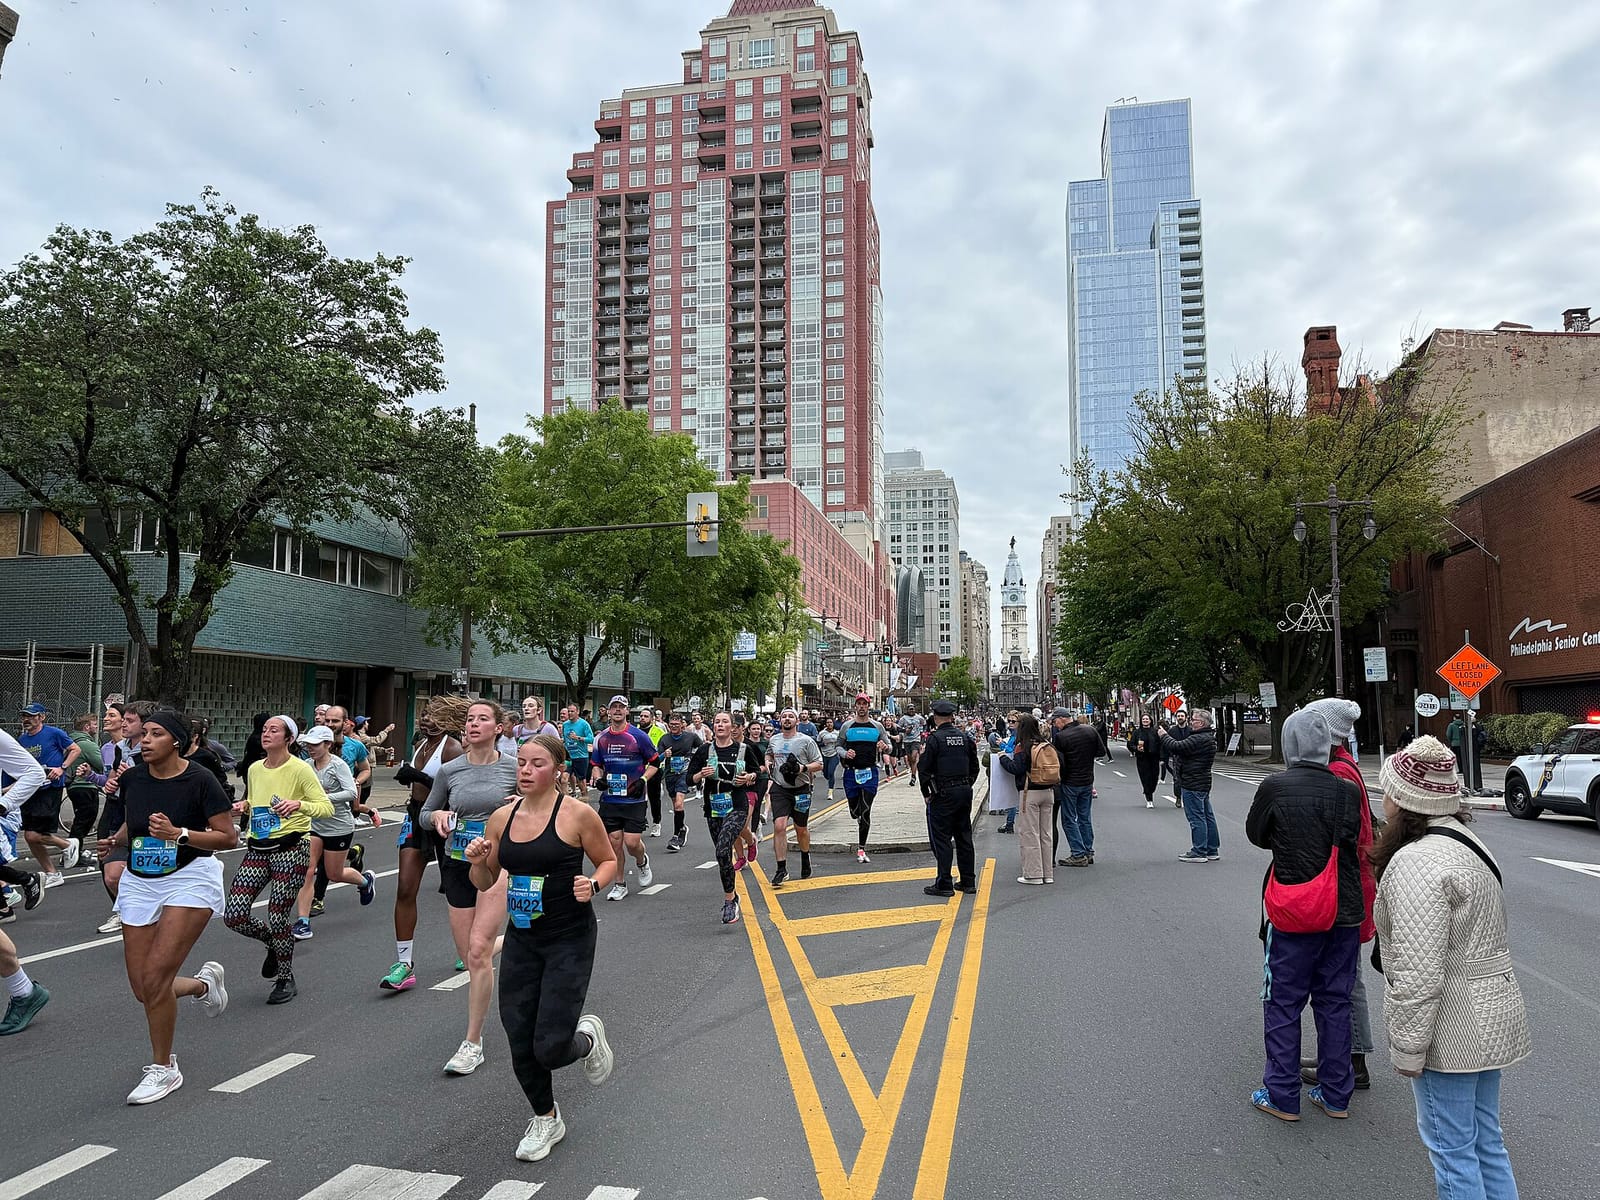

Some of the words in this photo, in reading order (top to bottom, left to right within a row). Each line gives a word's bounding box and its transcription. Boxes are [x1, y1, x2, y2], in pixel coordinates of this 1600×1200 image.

[1510, 638, 1553, 657] Philadelphia
[1554, 634, 1580, 651] Senior
[1450, 661, 1472, 671] LEFT
[1472, 662, 1490, 670] LANE
[1455, 671, 1483, 679] CLOSED
[136, 855, 170, 867] 8742
